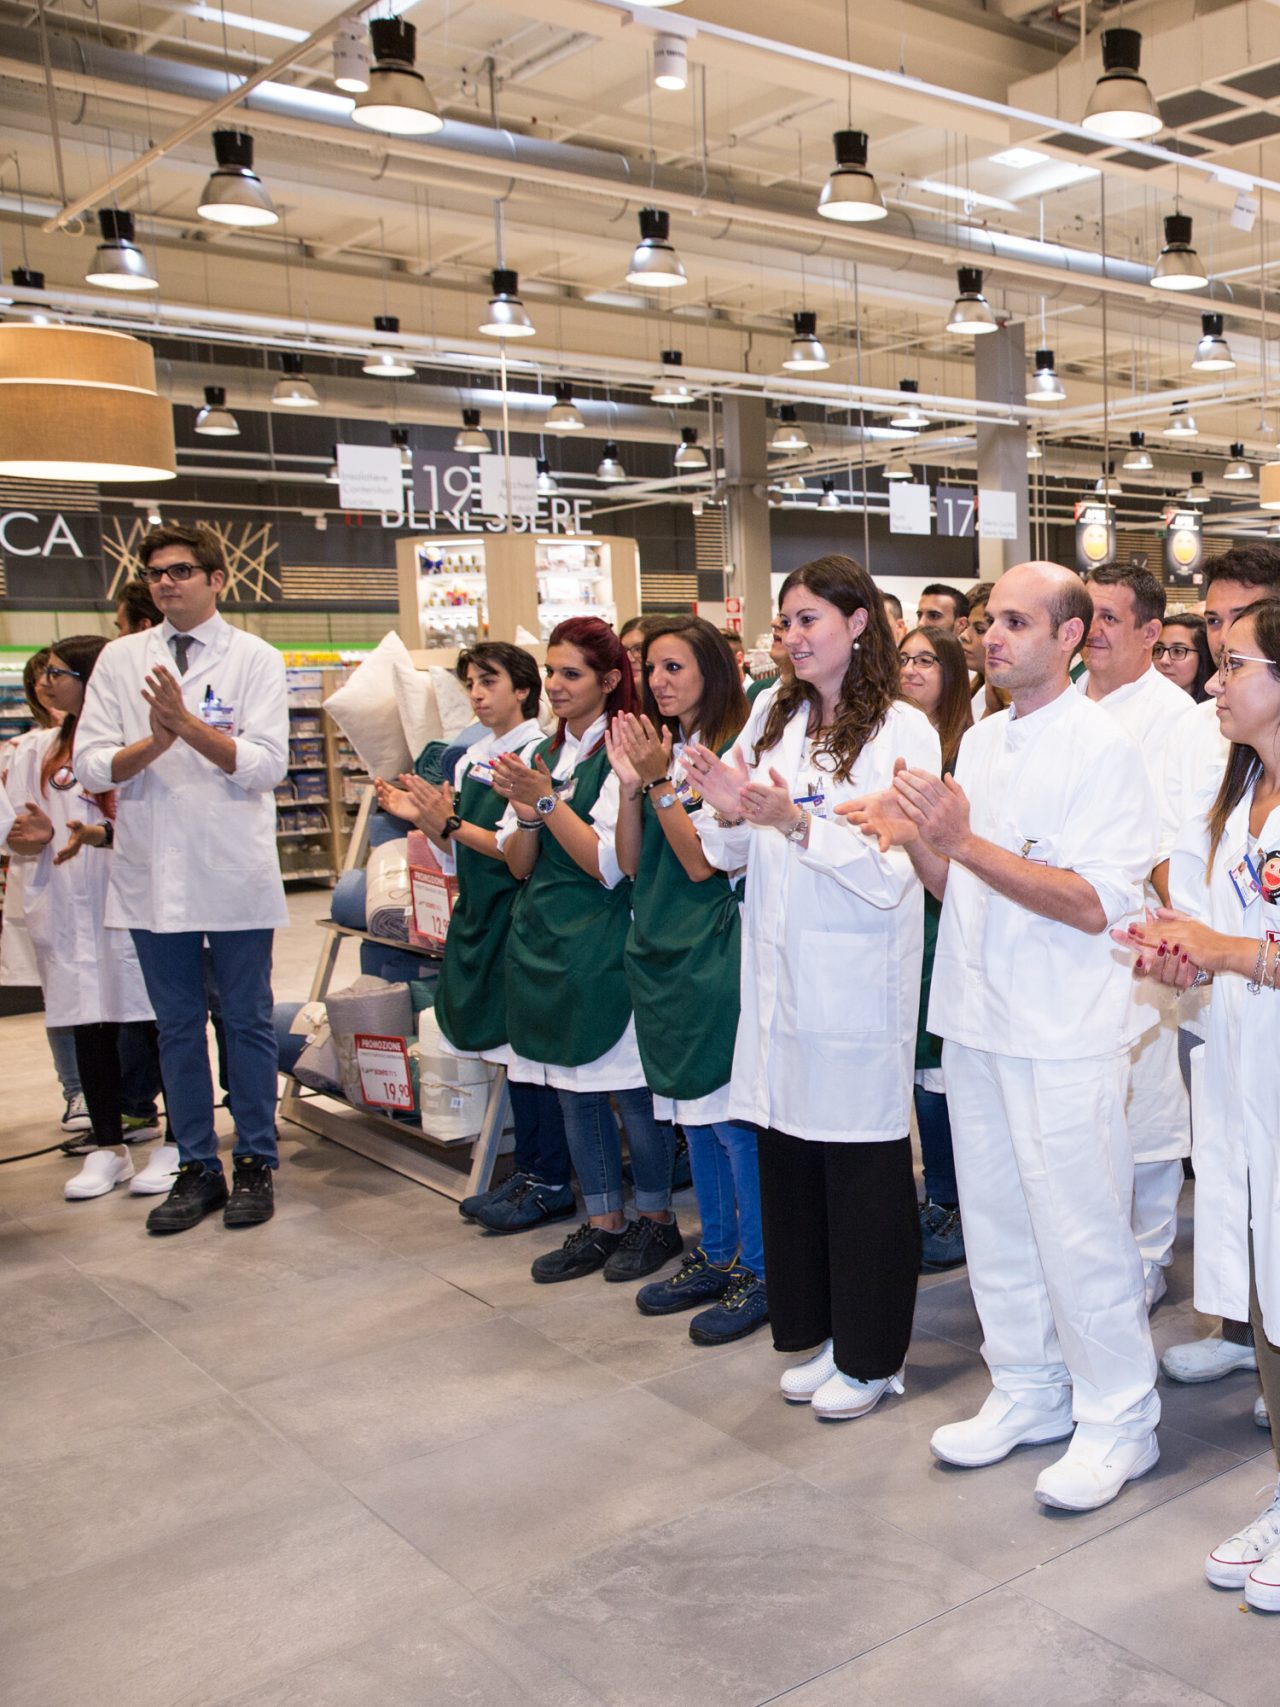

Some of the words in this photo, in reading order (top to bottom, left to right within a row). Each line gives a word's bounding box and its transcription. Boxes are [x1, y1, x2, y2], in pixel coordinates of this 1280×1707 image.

[423, 465, 473, 512] 19
[943, 498, 975, 537] 17
[361, 1039, 402, 1052] PROMOZIONE
[383, 1082, 410, 1105] 19,90
